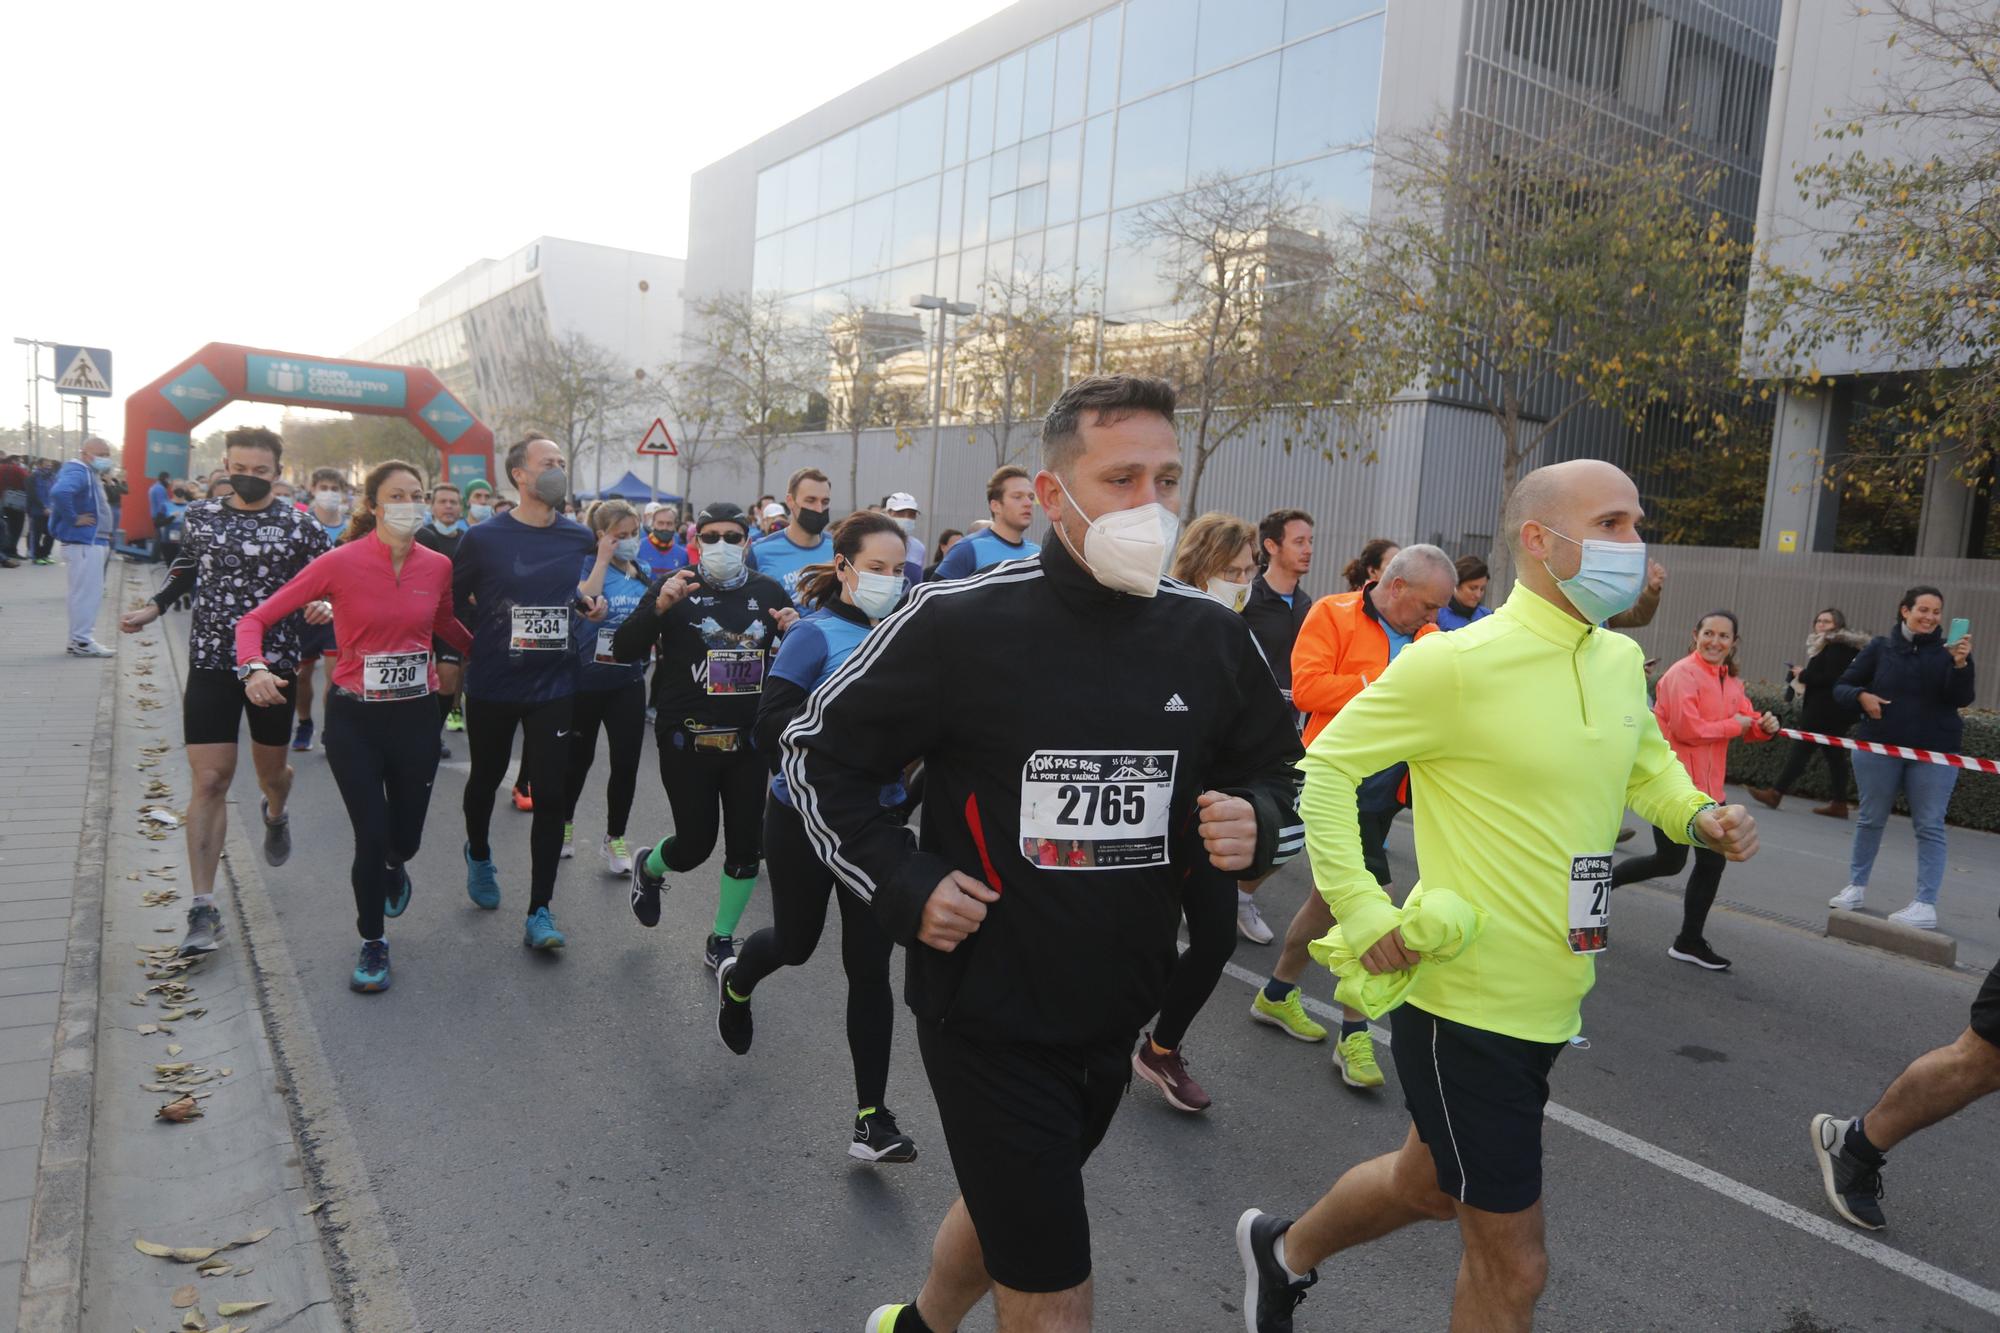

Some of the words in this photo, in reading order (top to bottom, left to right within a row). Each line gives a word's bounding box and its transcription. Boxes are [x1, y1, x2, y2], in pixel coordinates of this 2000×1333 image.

[308, 367, 349, 379] GRUPO
[308, 376, 389, 393] COOPERATIVO
[308, 384, 362, 398] CAJAMAR
[525, 620, 560, 634] 2534
[380, 667, 416, 684] 2730
[724, 662, 751, 678] 1772
[1029, 755, 1054, 772] 10K
[1054, 758, 1077, 769] PAS
[1079, 760, 1101, 773] RAS
[1072, 771, 1100, 781] VALÈNCIA
[1056, 784, 1146, 826] 2765
[1588, 859, 1600, 868] PAS
